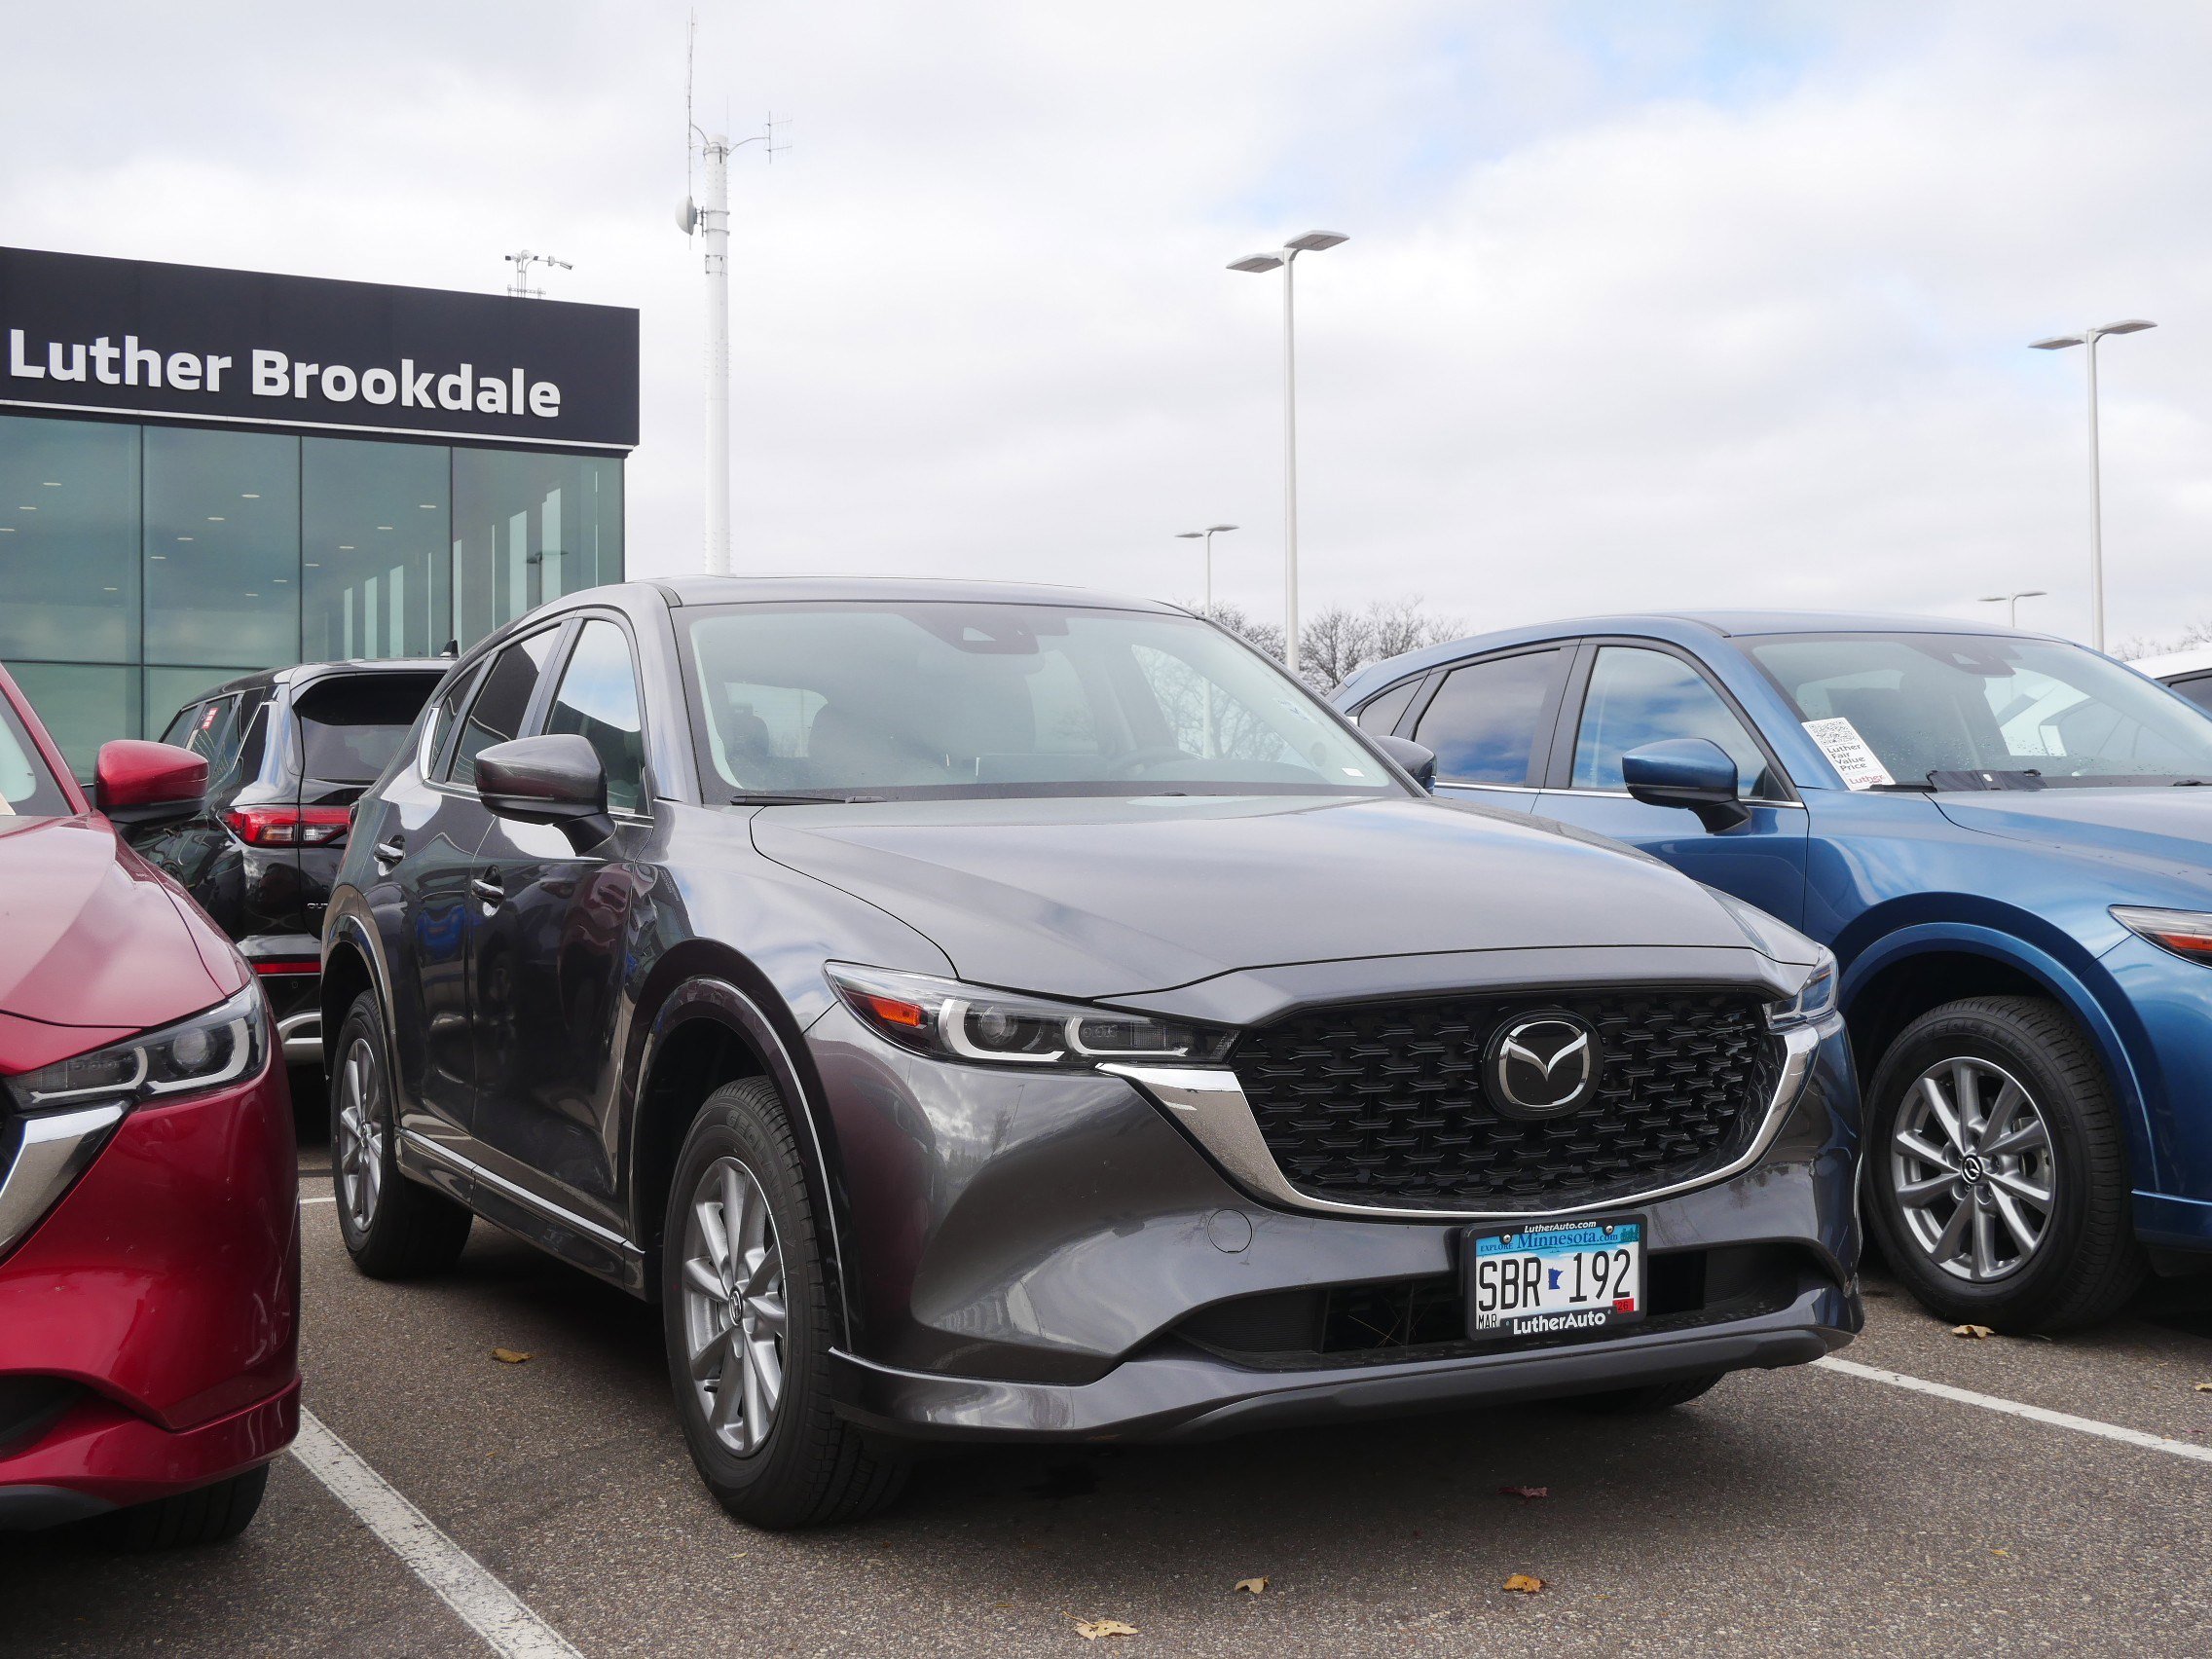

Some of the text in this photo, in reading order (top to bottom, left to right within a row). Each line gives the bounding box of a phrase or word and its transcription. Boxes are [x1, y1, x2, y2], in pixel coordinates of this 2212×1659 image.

[10, 328, 562, 419] Luther Brookdale
[1826, 744, 1862, 754] Luther
[1835, 756, 1866, 765] Value
[1840, 762, 1867, 772] Price
[1849, 774, 1884, 785] Luther
[1524, 1221, 1597, 1234] LutherAuto.com
[1480, 1231, 1618, 1252] EXPLORE Minnesota.com
[1478, 1248, 1632, 1312] SBR 192
[1478, 1313, 1497, 1329] MAR
[1513, 1311, 1606, 1335] LutherAuto
